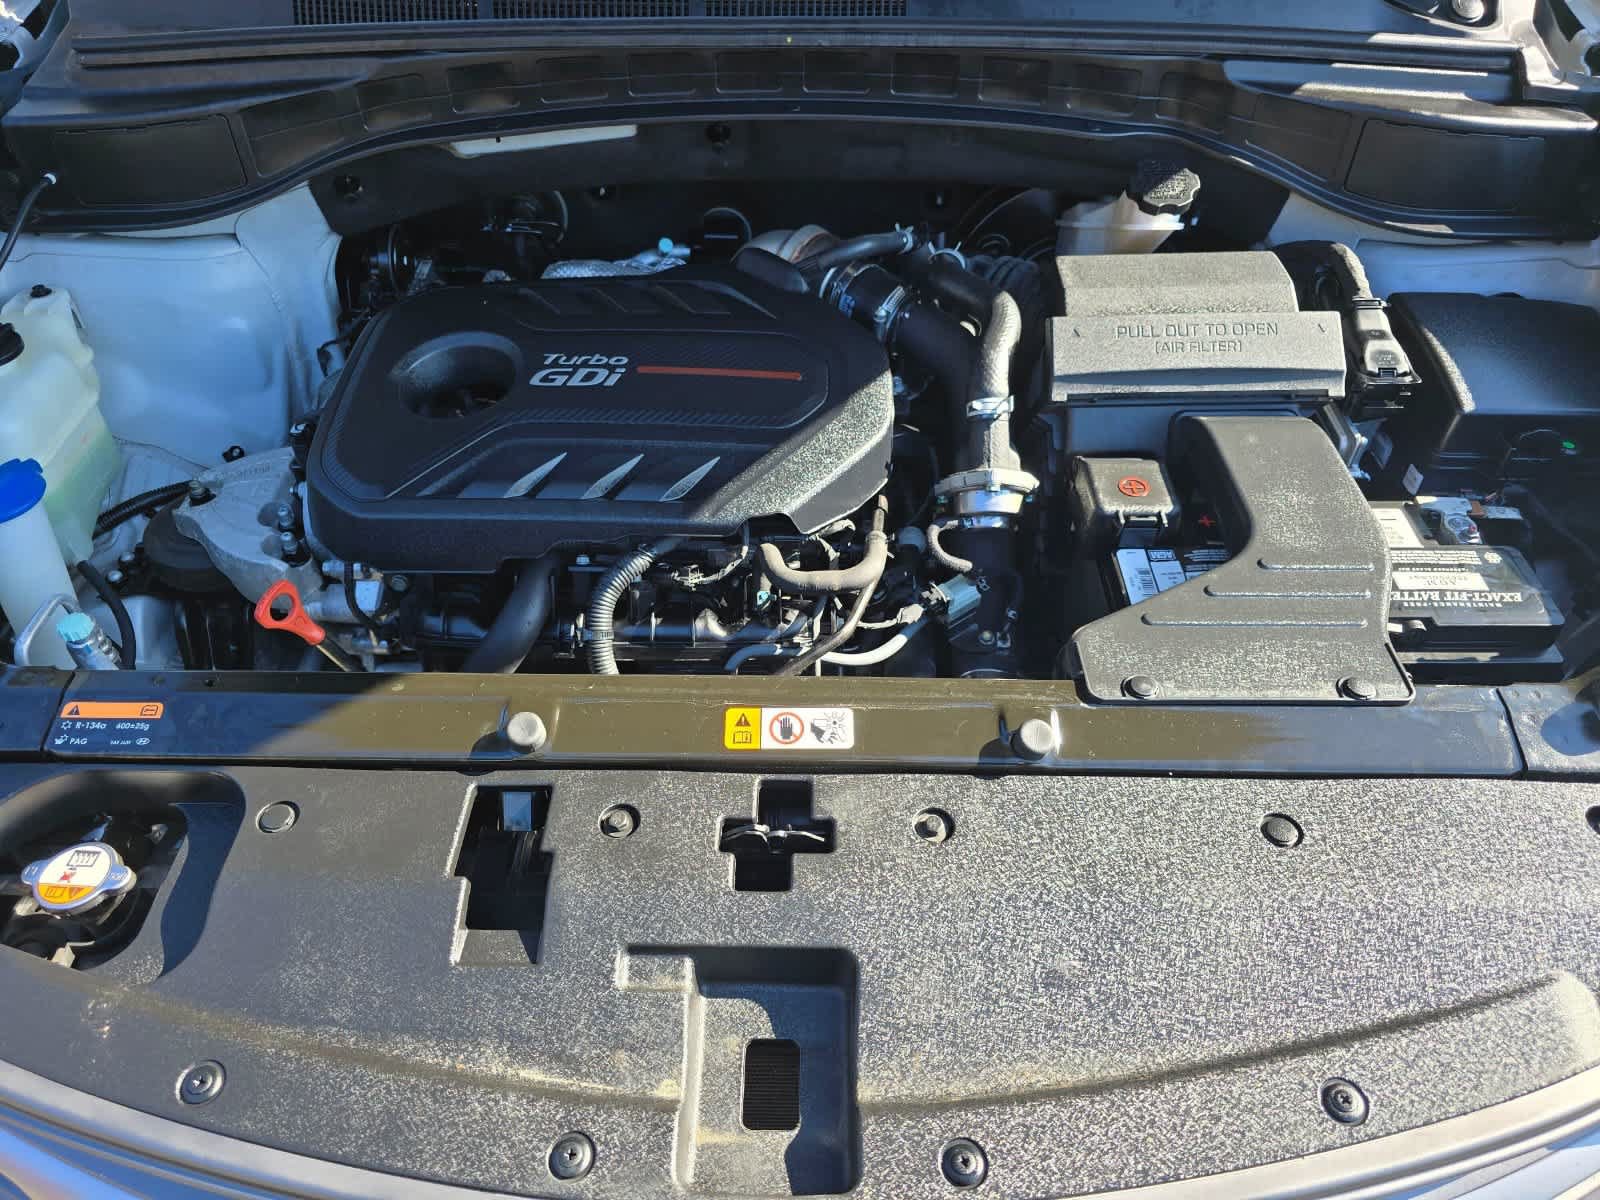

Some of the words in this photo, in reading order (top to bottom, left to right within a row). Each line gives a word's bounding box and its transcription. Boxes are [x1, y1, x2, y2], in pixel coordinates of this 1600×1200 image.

[1115, 325, 1160, 338] PULL
[1165, 324, 1200, 337] OUT
[1205, 323, 1227, 336] TO
[1232, 322, 1278, 336] OPEN
[543, 353, 629, 365] Turbo
[529, 367, 626, 386] GDi
[1444, 591, 1522, 602] EXACT-FIT
[69, 737, 88, 745] PAG
